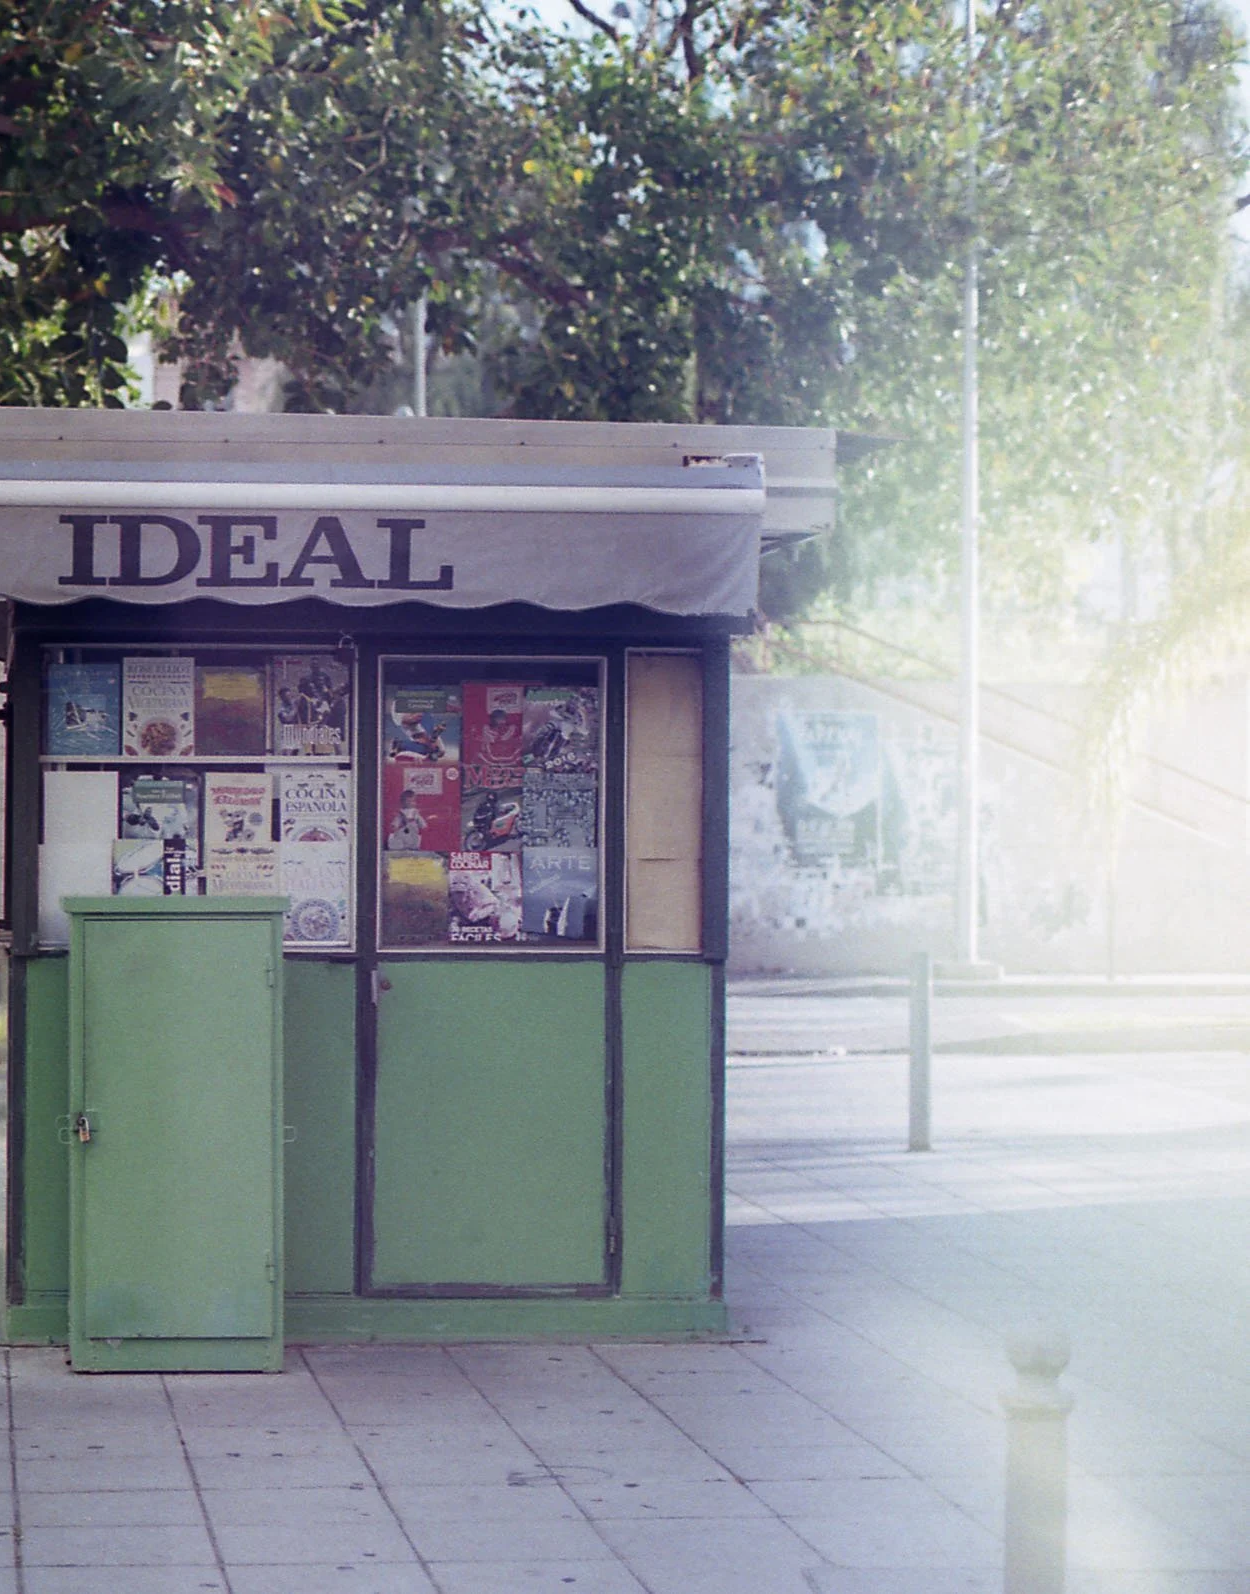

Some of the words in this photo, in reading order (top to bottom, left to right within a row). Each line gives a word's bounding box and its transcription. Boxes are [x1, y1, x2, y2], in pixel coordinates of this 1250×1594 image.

[58, 514, 453, 590] IDEAL
[545, 752, 576, 769] 2016
[285, 788, 346, 799] COCINA
[450, 852, 480, 860] SABER
[529, 855, 591, 870] ARTE
